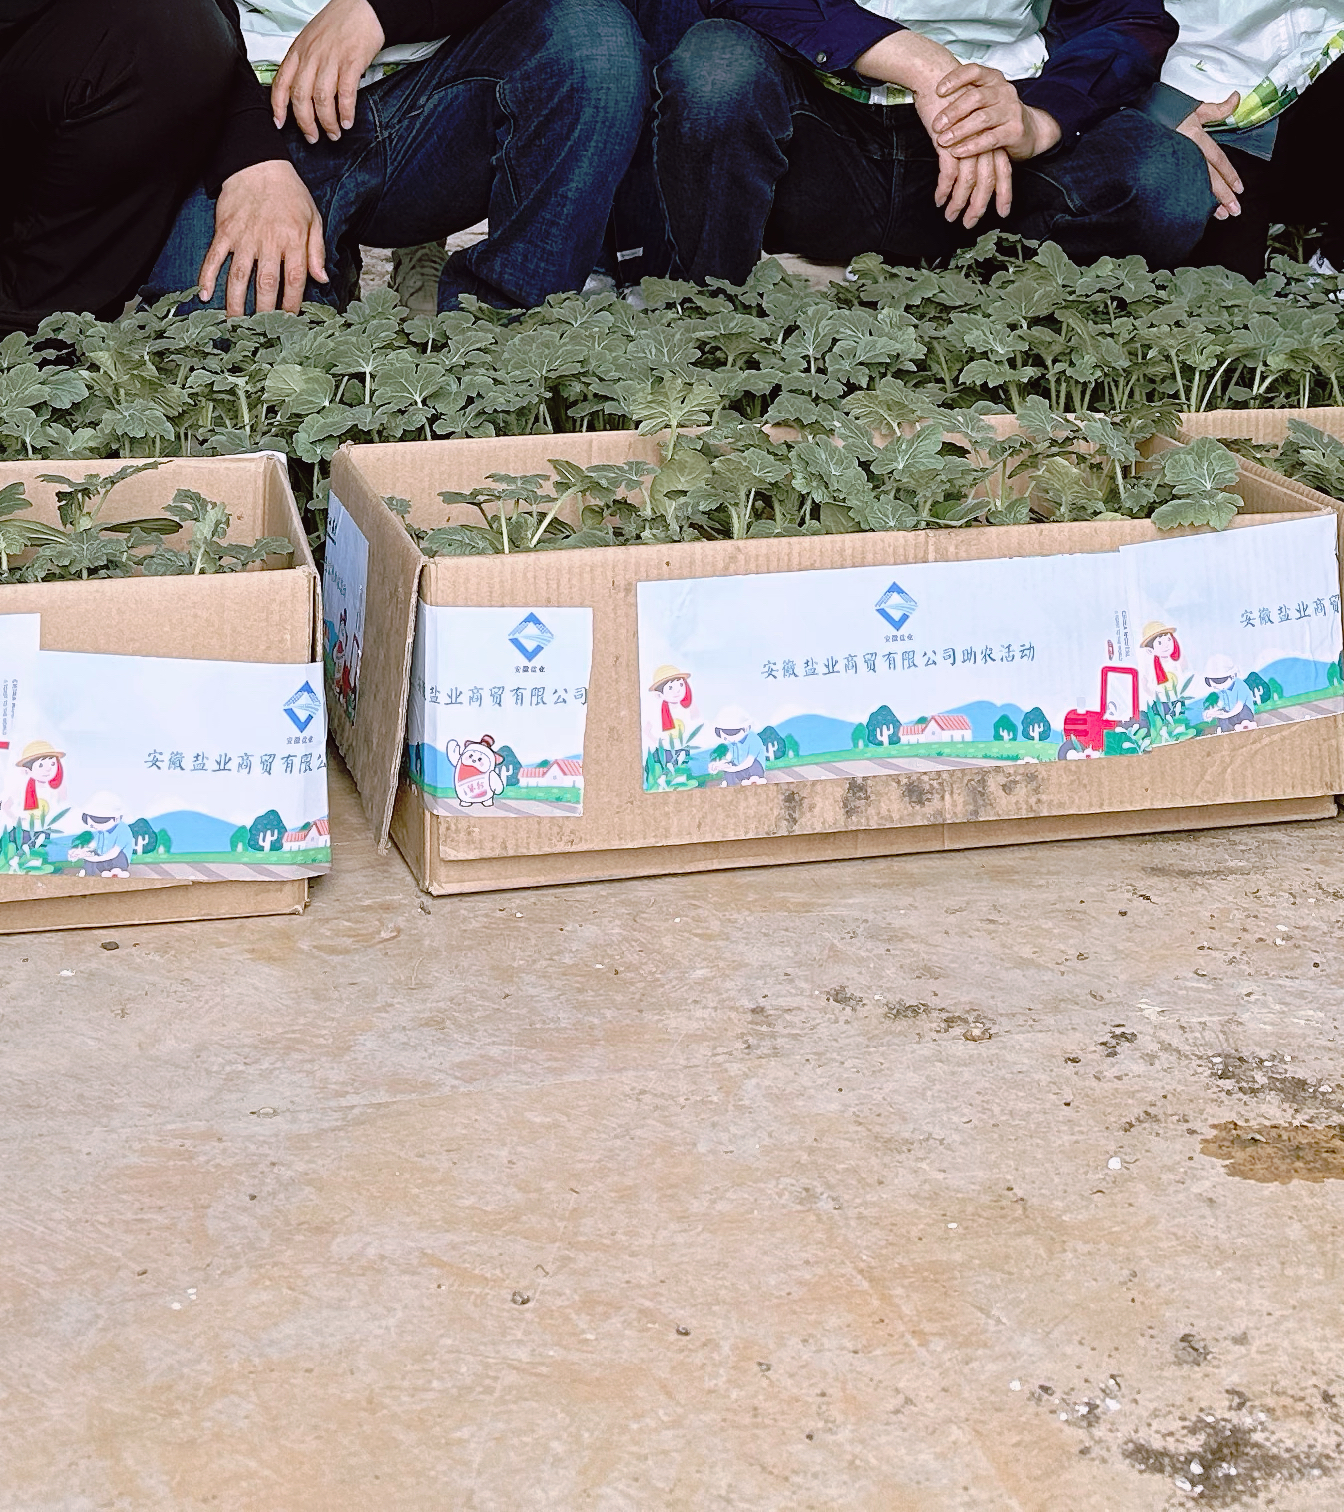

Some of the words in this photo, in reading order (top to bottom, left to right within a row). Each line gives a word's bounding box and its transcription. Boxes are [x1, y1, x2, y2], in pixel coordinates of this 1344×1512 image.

[760, 641, 1036, 679] 安徽盐业商贸有限公司助农活动
